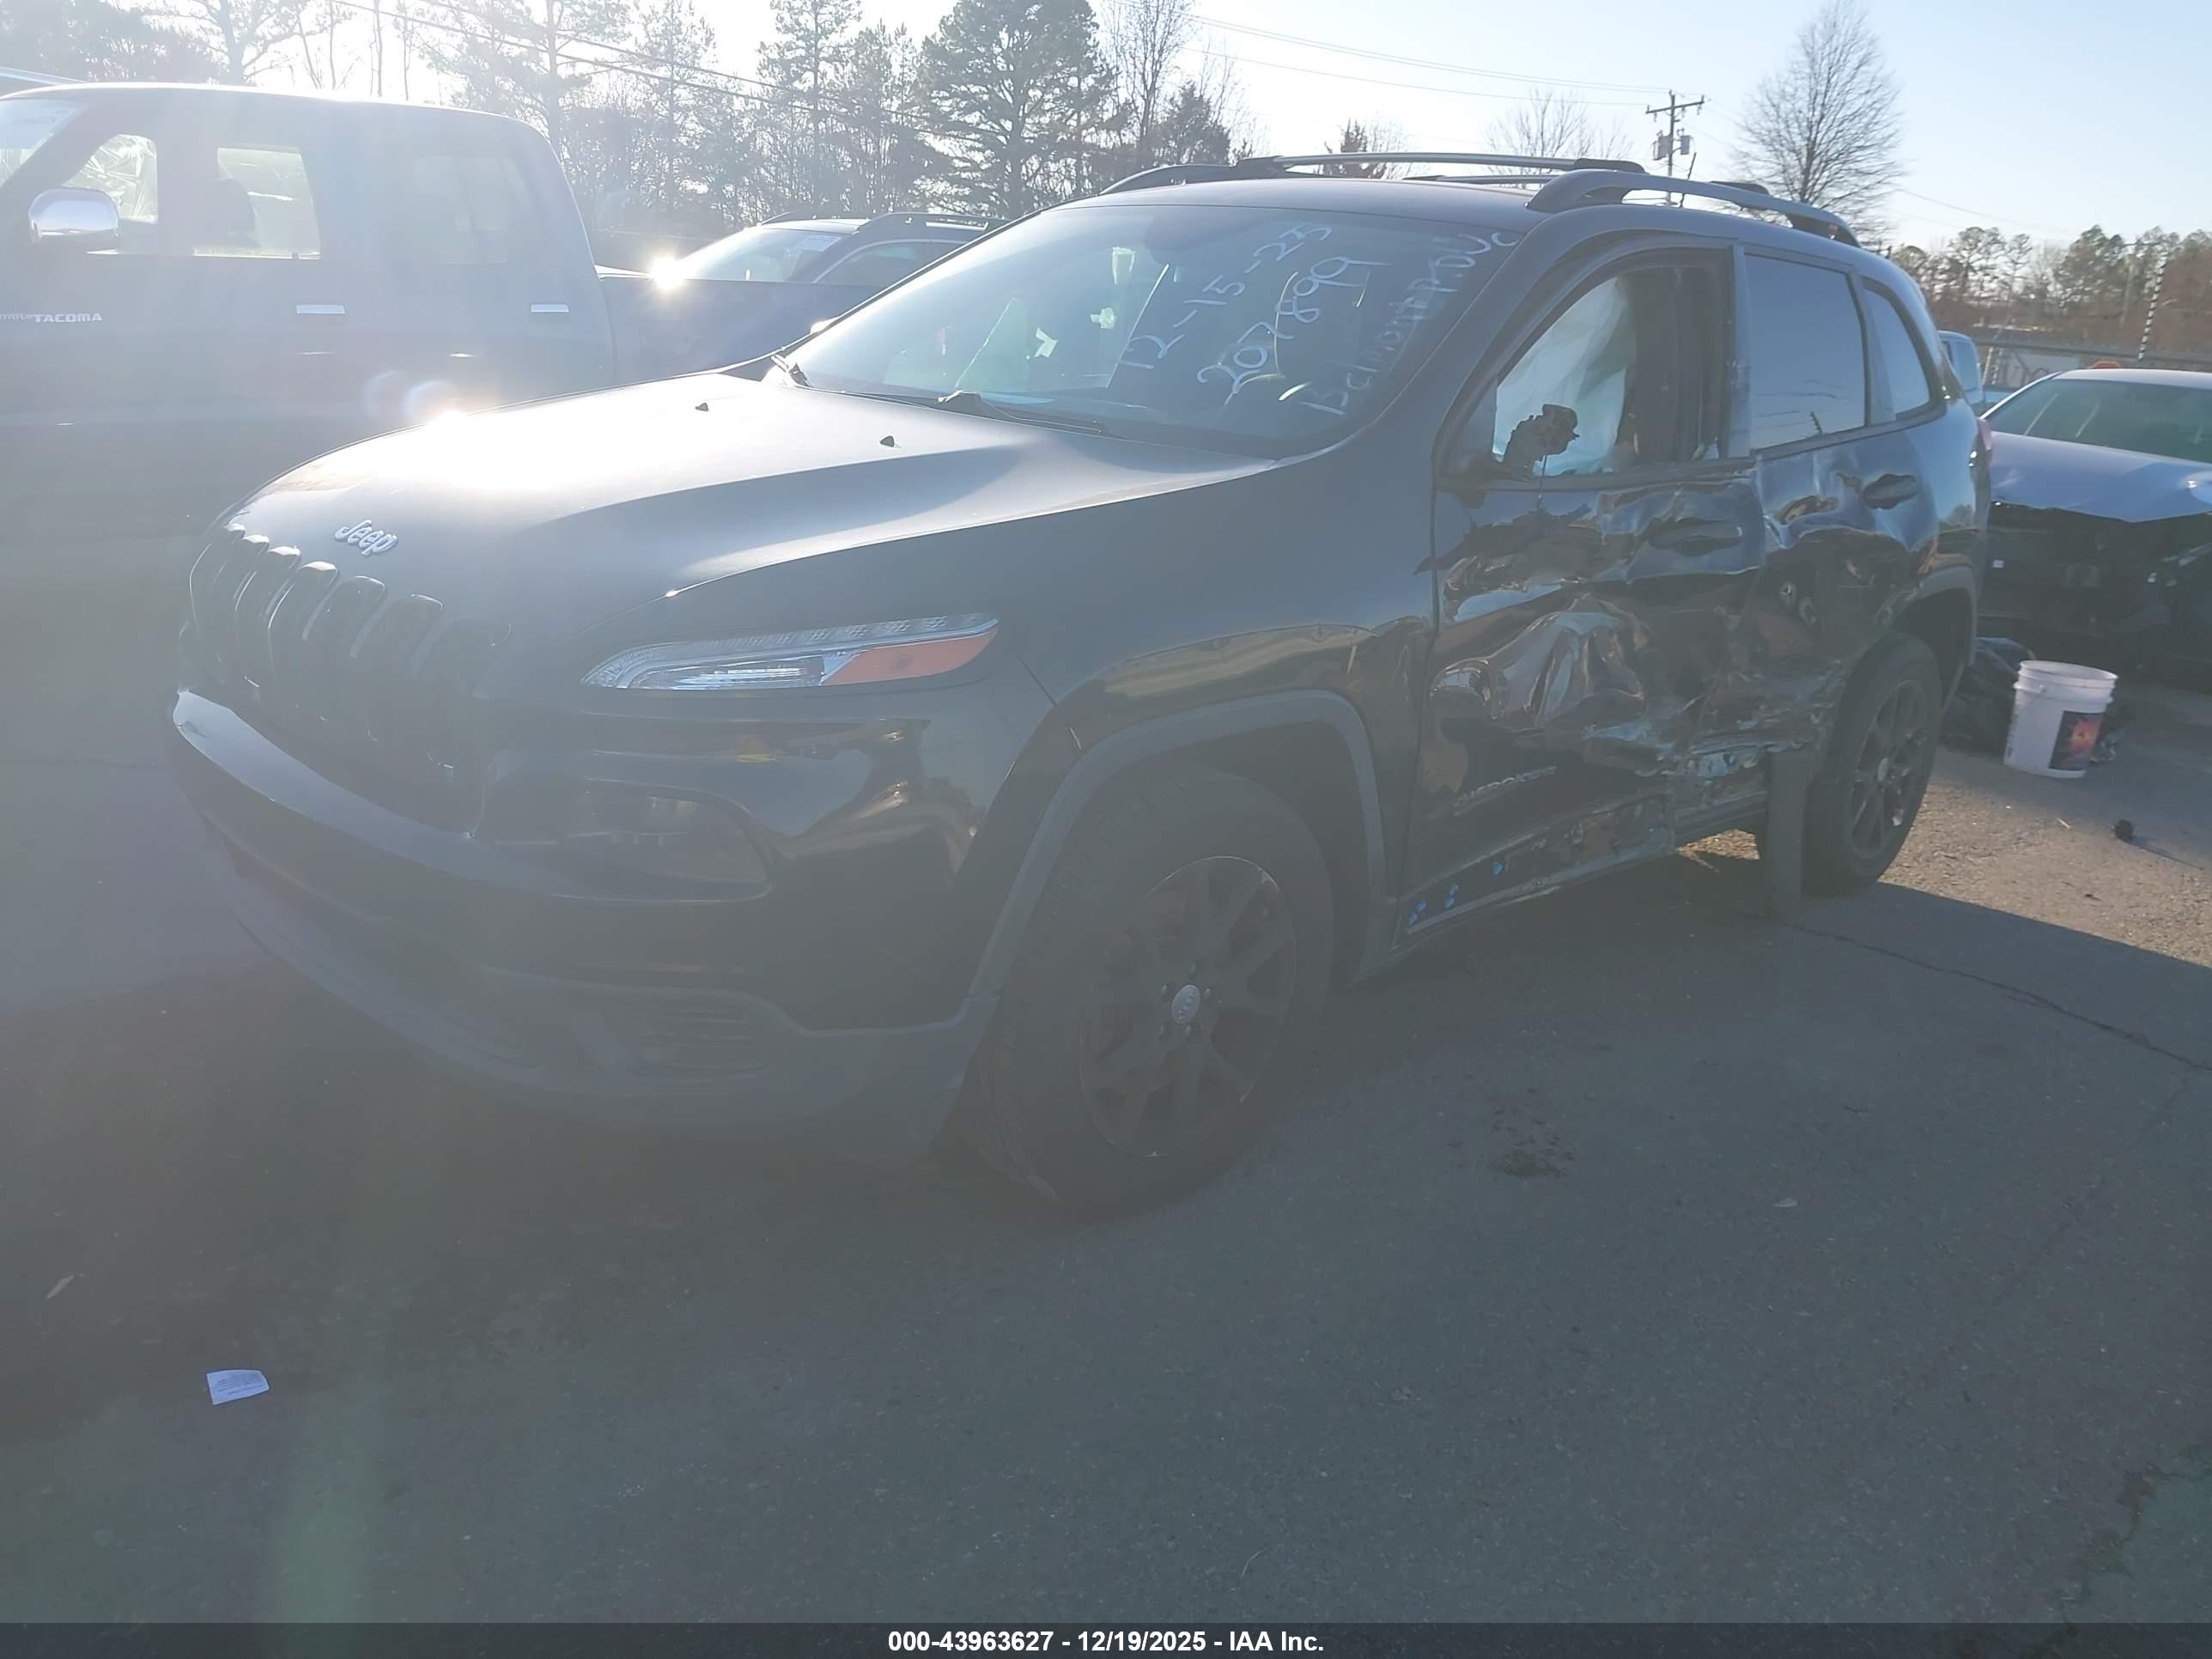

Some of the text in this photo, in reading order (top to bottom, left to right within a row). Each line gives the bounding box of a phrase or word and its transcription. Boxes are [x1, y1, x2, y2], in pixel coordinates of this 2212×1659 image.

[1120, 225, 1333, 370] 12-15-25
[34, 313, 103, 323] TACOMA
[334, 519, 398, 556] Jeep
